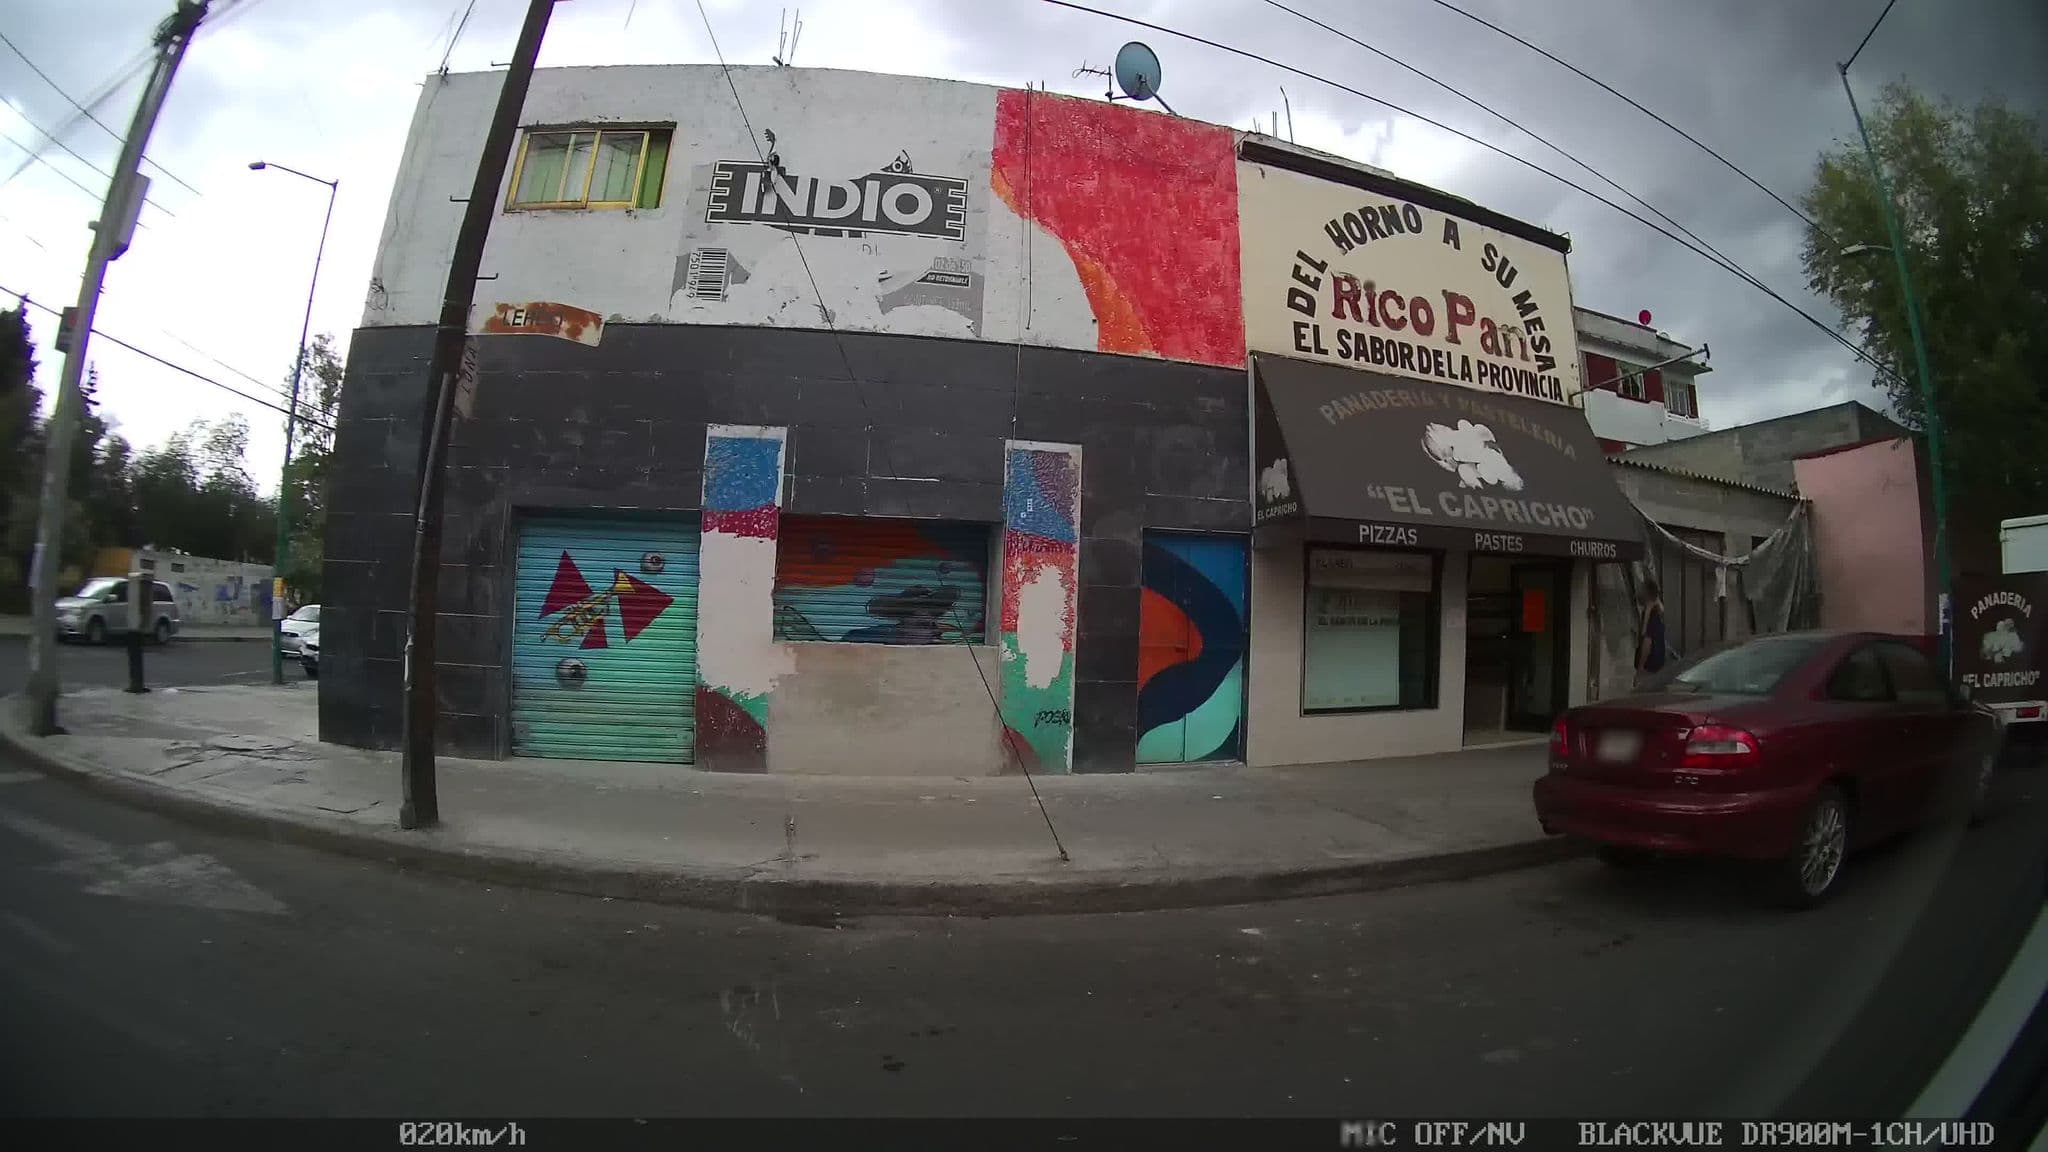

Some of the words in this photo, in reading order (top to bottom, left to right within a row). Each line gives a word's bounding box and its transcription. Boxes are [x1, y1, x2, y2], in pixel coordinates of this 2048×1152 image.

[741, 172, 933, 226] INDIO
[1287, 249, 1329, 318] DEL
[1324, 203, 1423, 255] HORNO
[1442, 218, 1461, 250] A
[1481, 242, 1518, 289] SU
[1511, 289, 1557, 373] MESA
[1331, 271, 1435, 337] Rico
[1442, 289, 1531, 362] Pan
[1293, 320, 1329, 356] EL
[1337, 329, 1416, 373] SABOR
[1476, 359, 1564, 402] PROVINCIA
[1320, 389, 1435, 425] PANADERIA
[1359, 523, 1418, 546] PIZZAS
[1474, 532, 1523, 552] PASTES
[1570, 540, 1617, 558] CHURROS
[1970, 591, 2033, 620] PANADERIA
